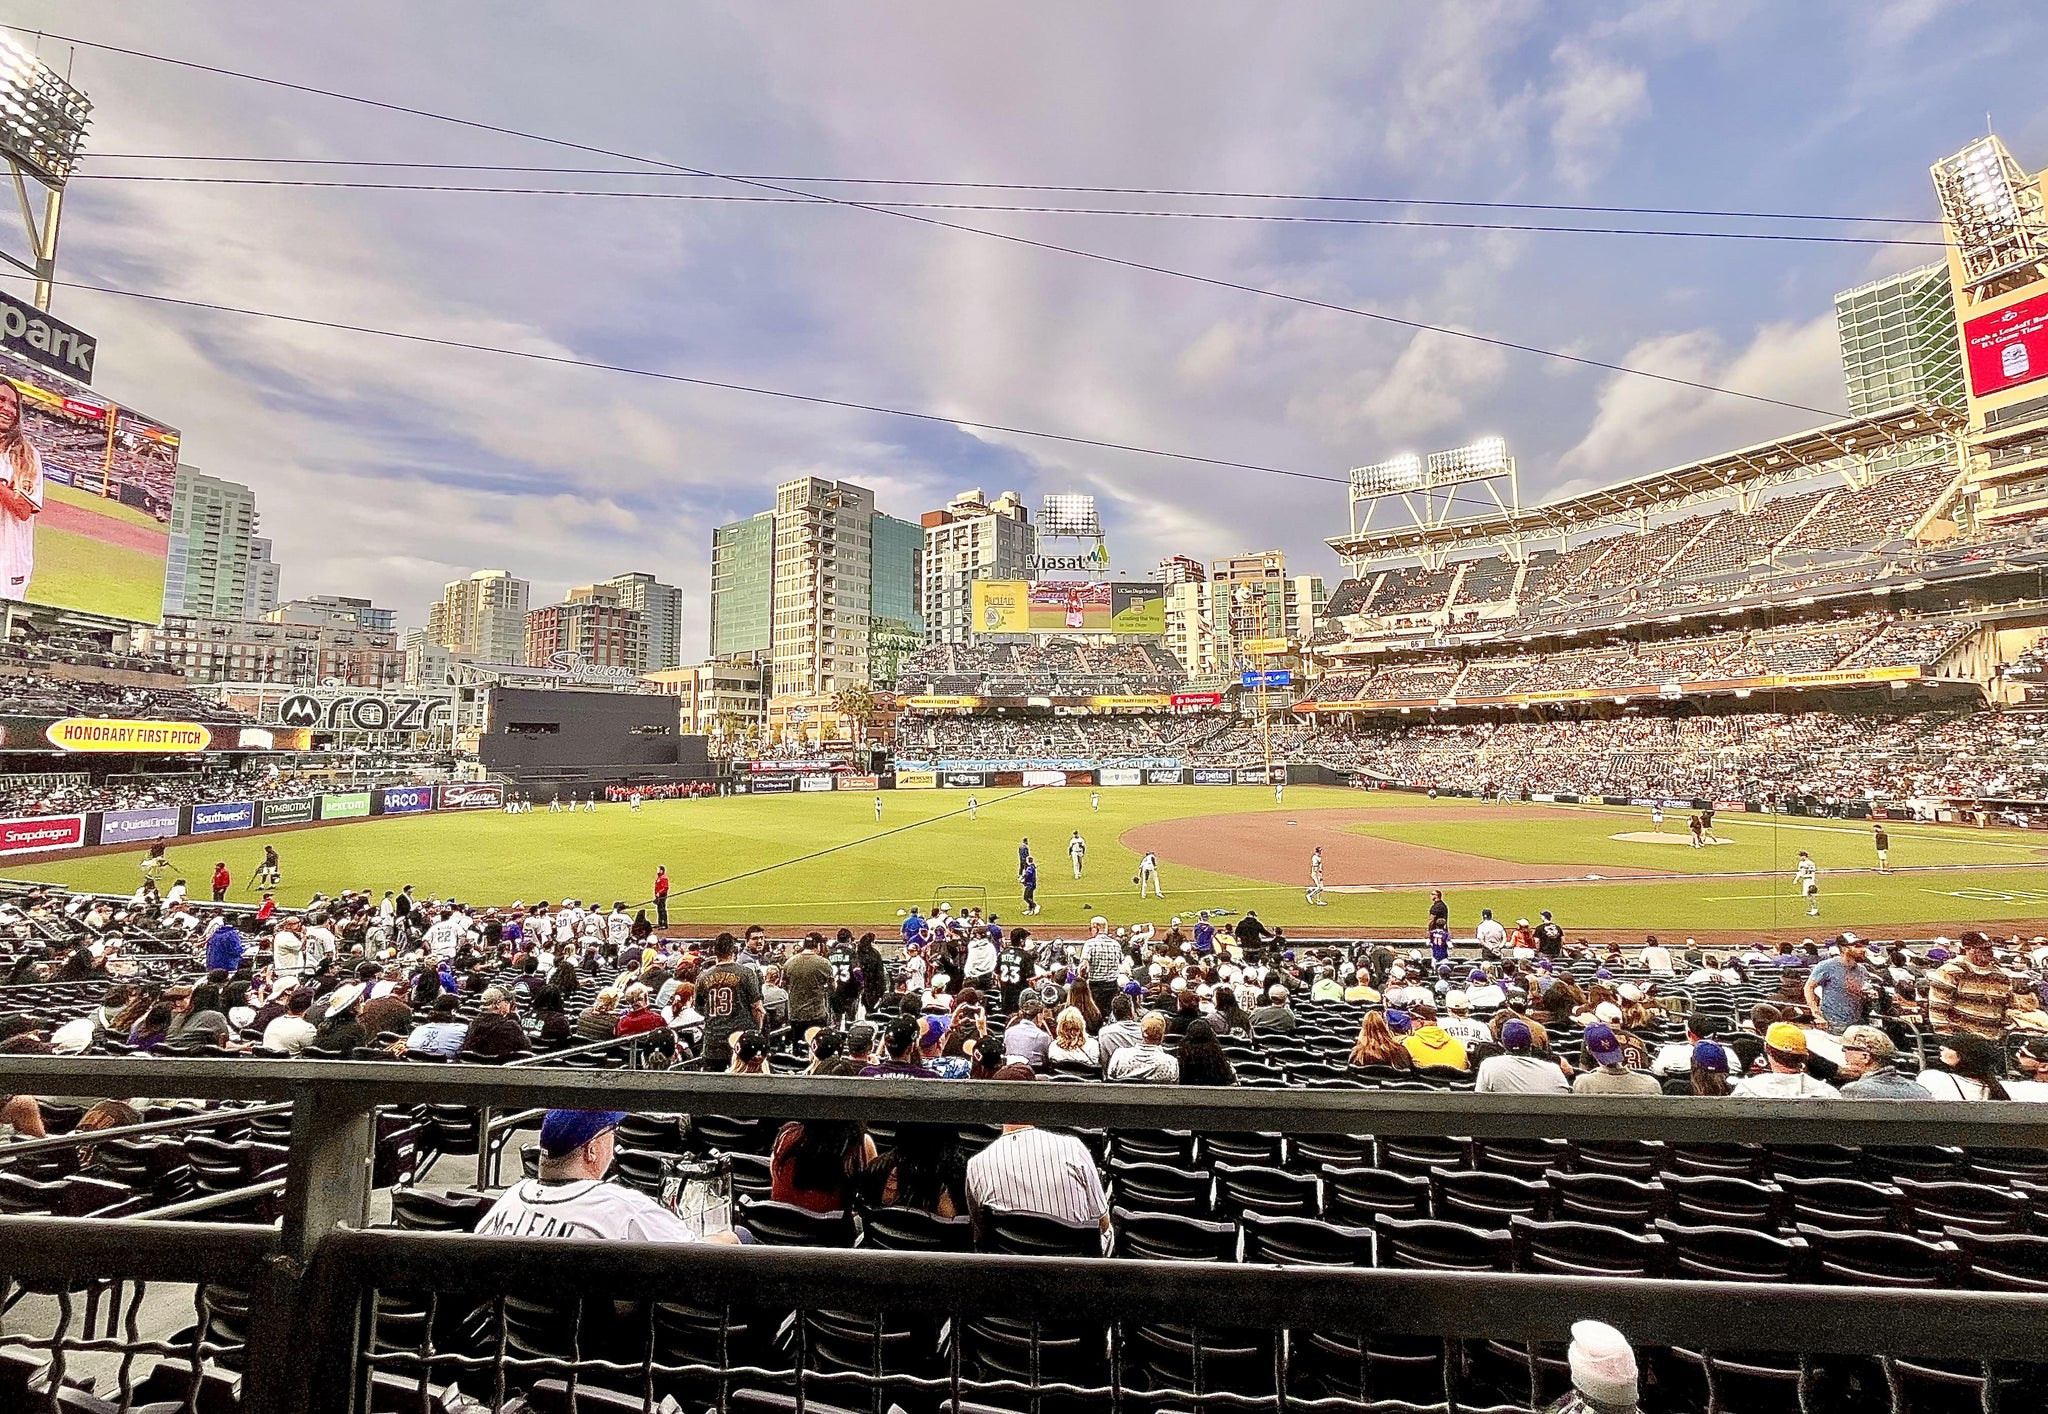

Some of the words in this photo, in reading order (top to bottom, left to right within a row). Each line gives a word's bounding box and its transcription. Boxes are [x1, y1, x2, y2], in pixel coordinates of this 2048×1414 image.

[0, 302, 94, 371] park
[1971, 334, 1991, 345] Grab
[1995, 332, 2020, 343] Game
[2020, 324, 2044, 335] Time
[1029, 554, 1086, 570] Viasat
[545, 650, 635, 683] Sycuan
[1788, 675, 1823, 683] HONORARY
[1185, 696, 1214, 704] Budweiser
[326, 696, 448, 731] razr
[63, 725, 134, 741] HONORARY
[136, 729, 169, 743] FIRST
[170, 731, 201, 744] PITCH
[1206, 771, 1229, 780] petco
[384, 793, 419, 808] ARCO
[121, 818, 177, 830] QuidelOrtho
[195, 809, 244, 825] Southwest
[4, 827, 72, 842] Snapdragon
[437, 930, 451, 942] 22
[1000, 965, 1020, 983] 23
[709, 987, 733, 1017] 13
